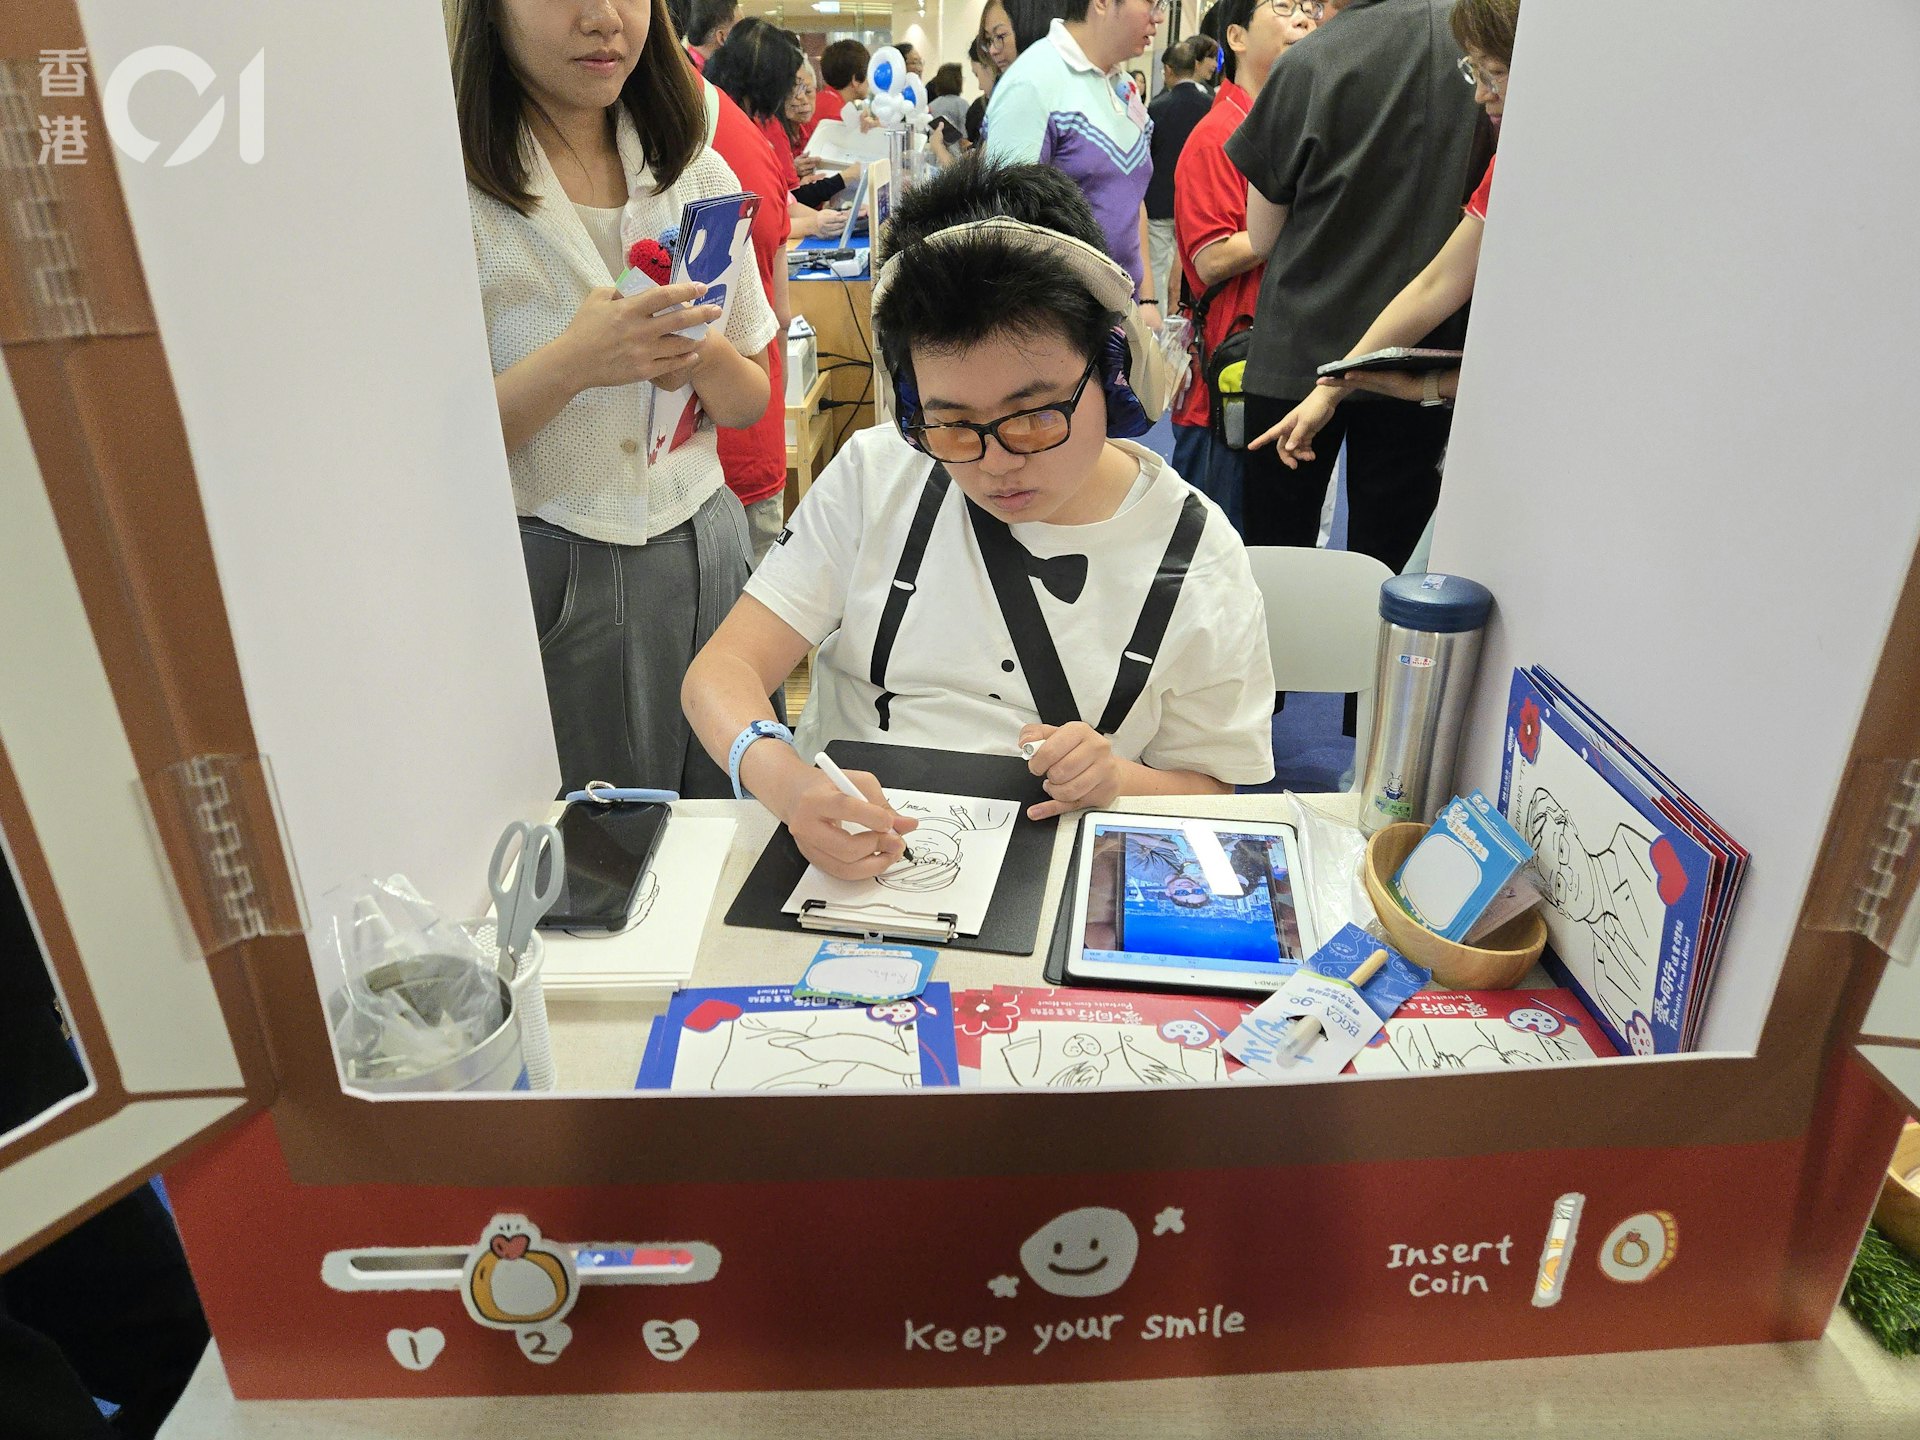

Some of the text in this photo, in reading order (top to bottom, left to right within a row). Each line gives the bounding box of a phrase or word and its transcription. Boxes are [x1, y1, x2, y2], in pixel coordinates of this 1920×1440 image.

[1432, 993, 1473, 1002] Portraits
[1669, 936, 1691, 1031] Portraits from the Heart
[1094, 1002, 1133, 1010] Portraits
[1326, 1006, 1360, 1037] BGCA
[1387, 1235, 1513, 1269] Insert
[1409, 1270, 1489, 1297] Coin
[654, 1326, 684, 1354] 3
[905, 1303, 1246, 1356] Keep your smile
[408, 1336, 422, 1365] 1
[524, 1331, 557, 1357] 2
